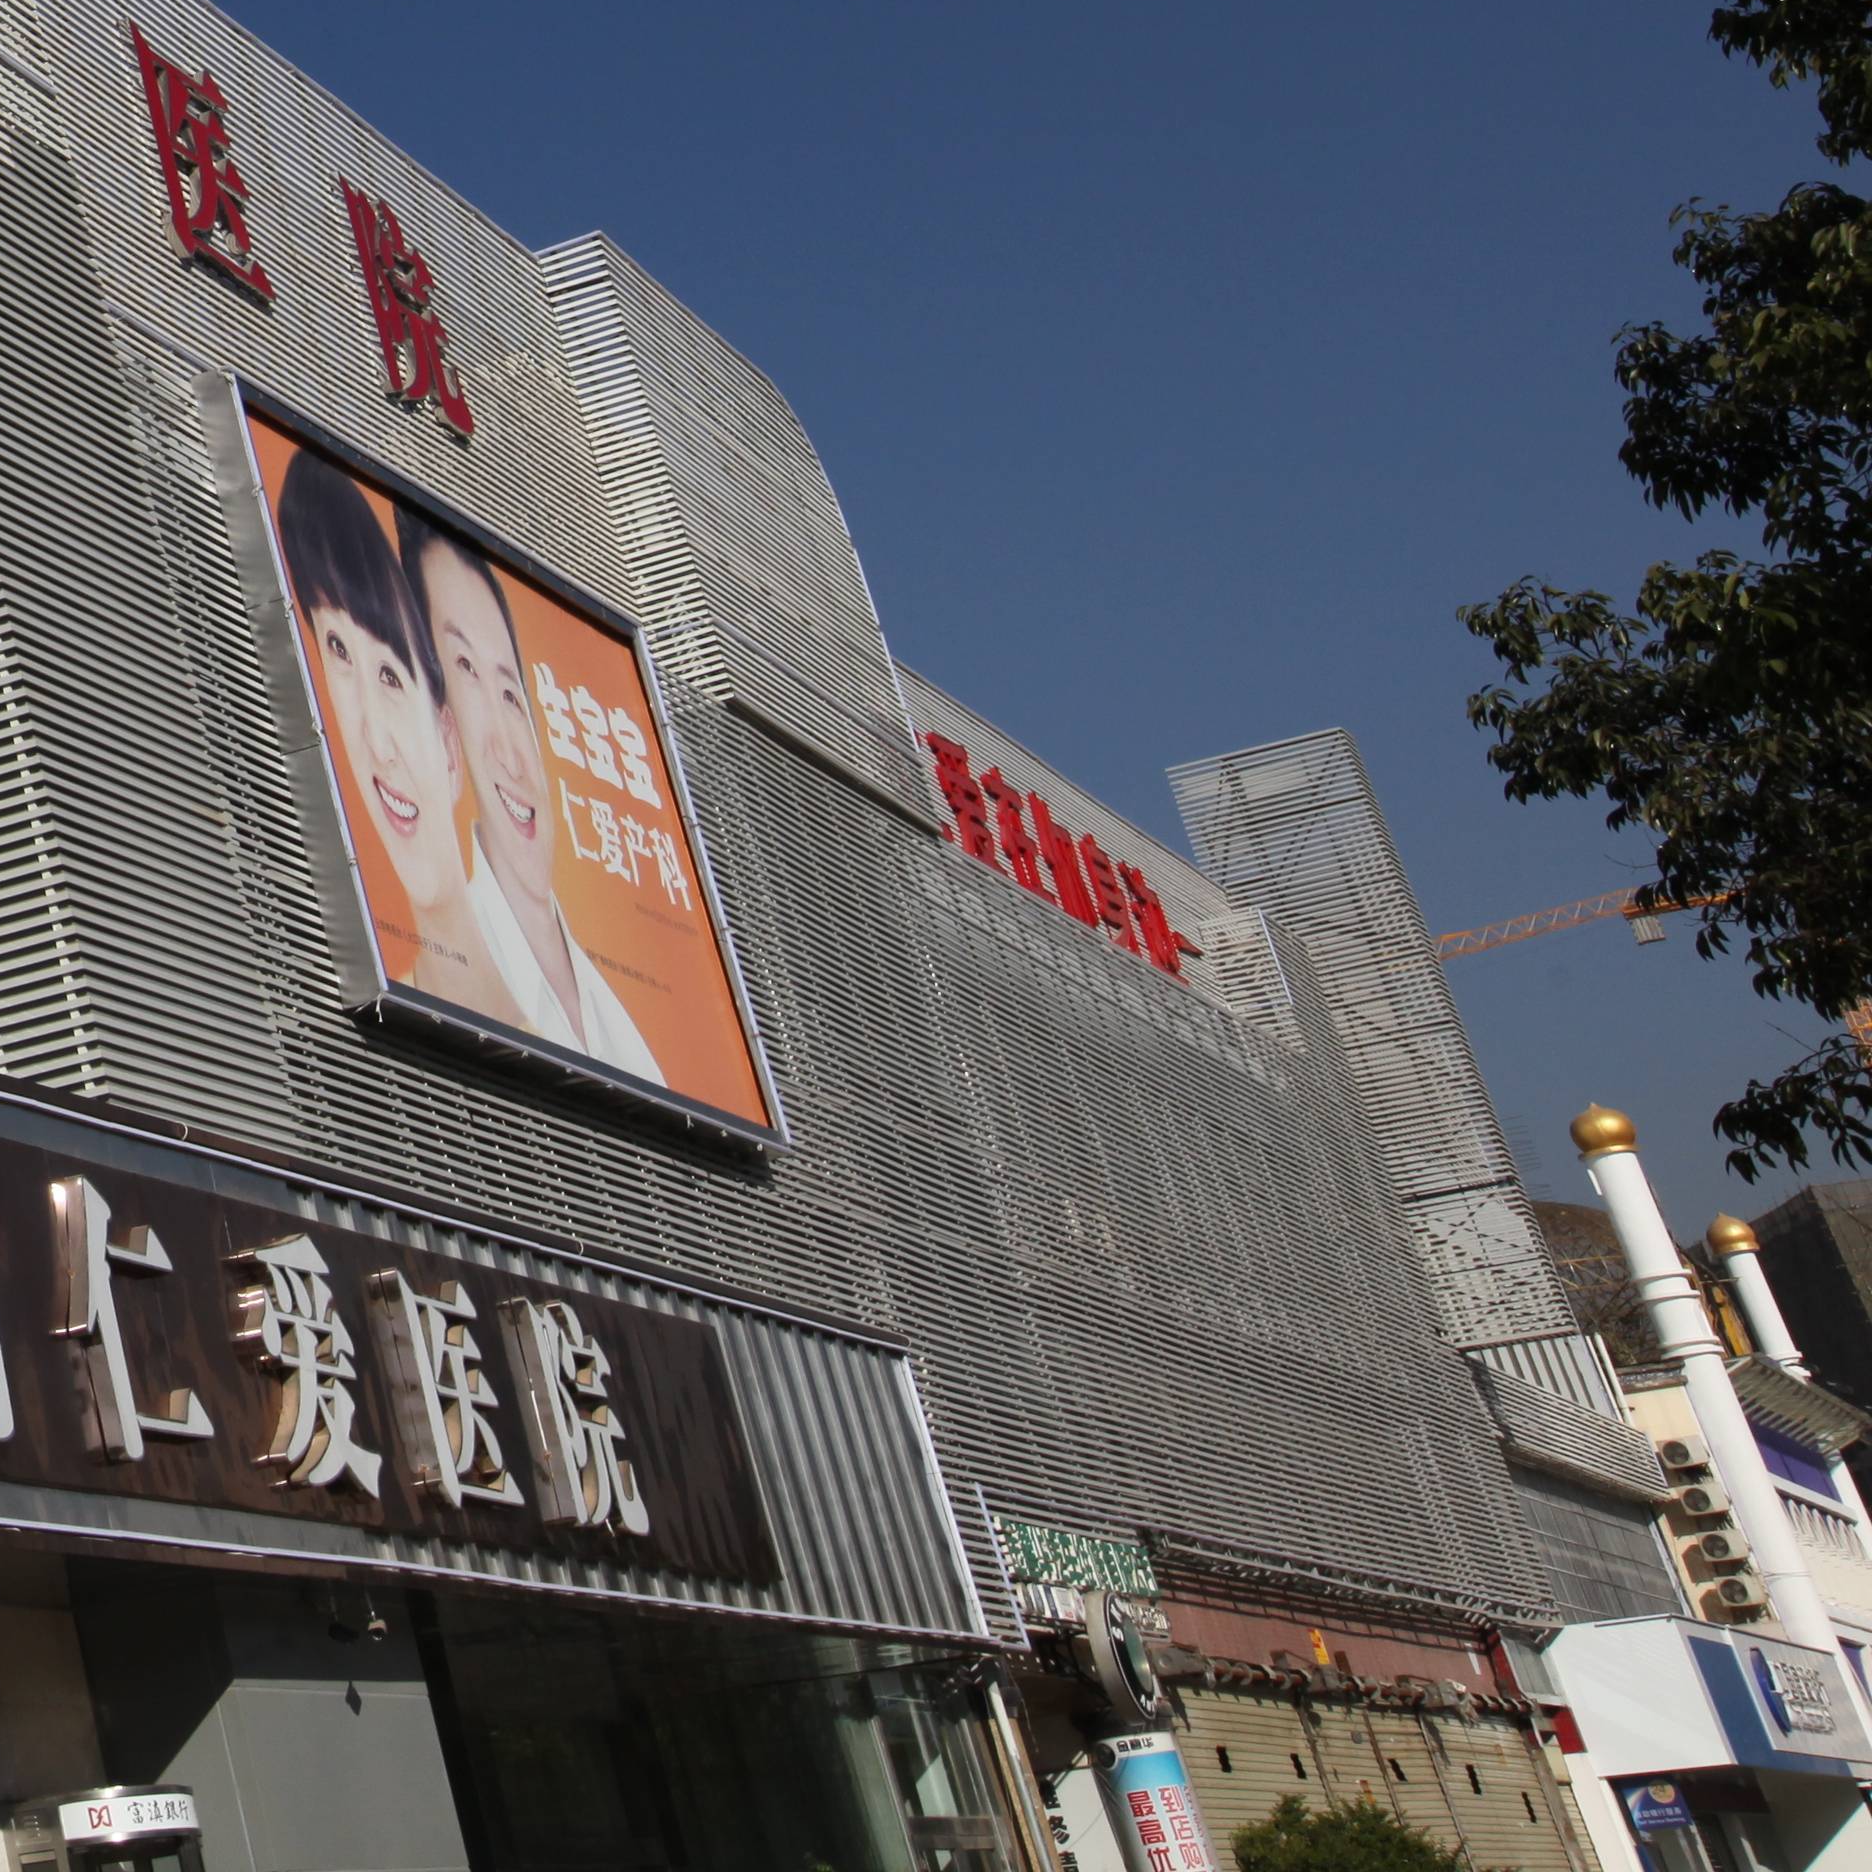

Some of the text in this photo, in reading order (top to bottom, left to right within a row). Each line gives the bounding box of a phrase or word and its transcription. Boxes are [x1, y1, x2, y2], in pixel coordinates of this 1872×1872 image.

[532, 661, 662, 810] 生宝宝
[557, 777, 693, 912] 仁爱产科
